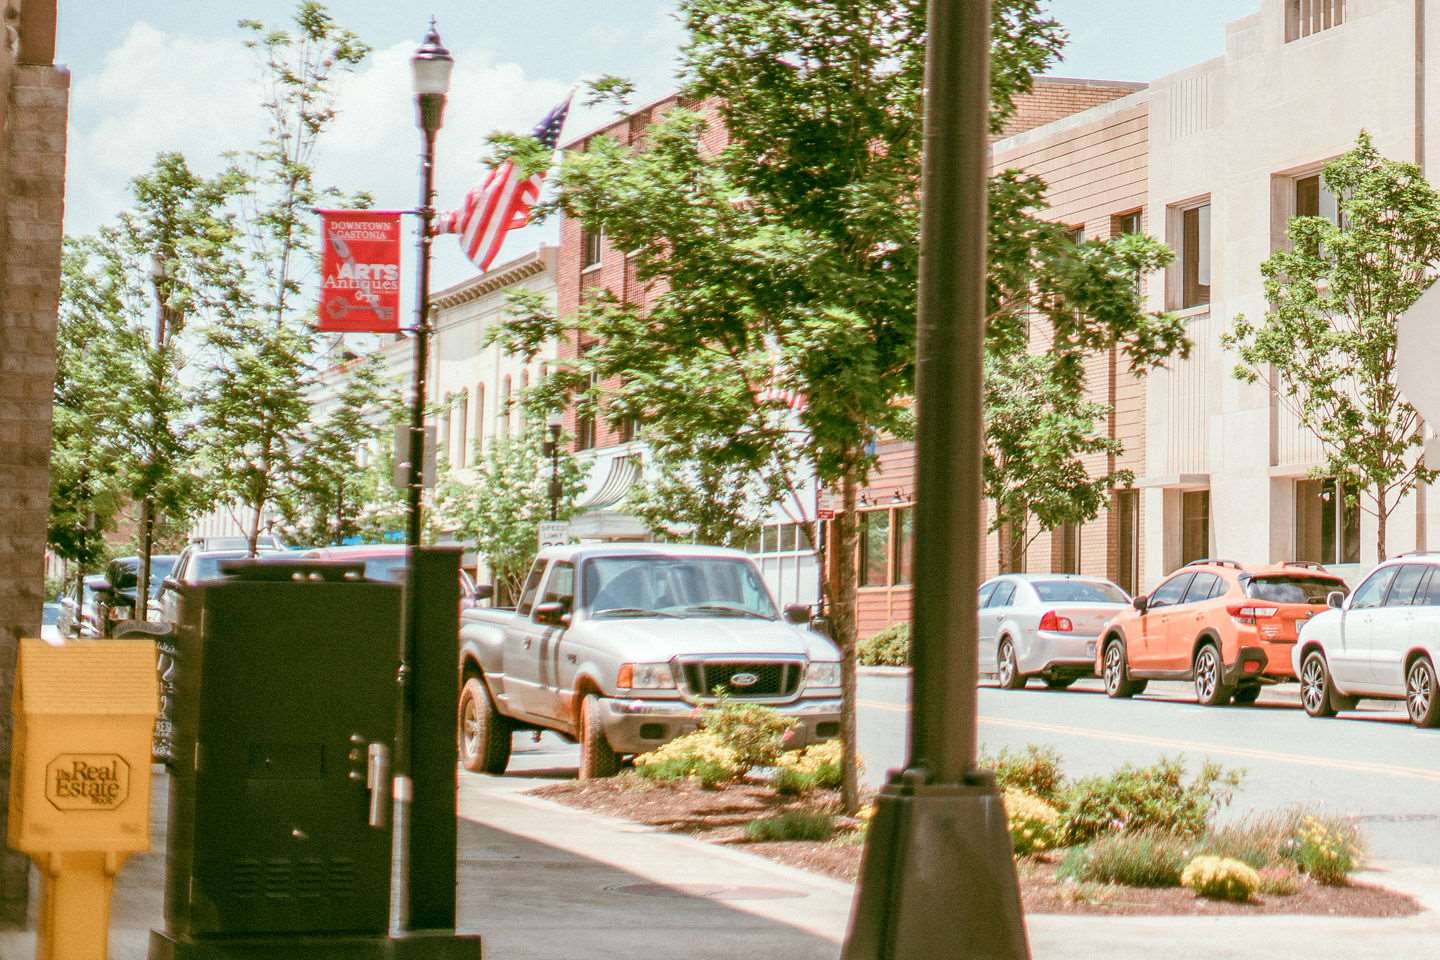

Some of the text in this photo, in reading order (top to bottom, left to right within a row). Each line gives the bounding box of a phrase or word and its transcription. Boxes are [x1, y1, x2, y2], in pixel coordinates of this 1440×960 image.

[331, 222, 391, 230] DOWNTOWN
[337, 230, 387, 240] GASTONIA
[338, 263, 399, 281] ARTS
[323, 274, 399, 293] Antiques
[72, 760, 117, 781] Real
[56, 778, 120, 798] Estate
